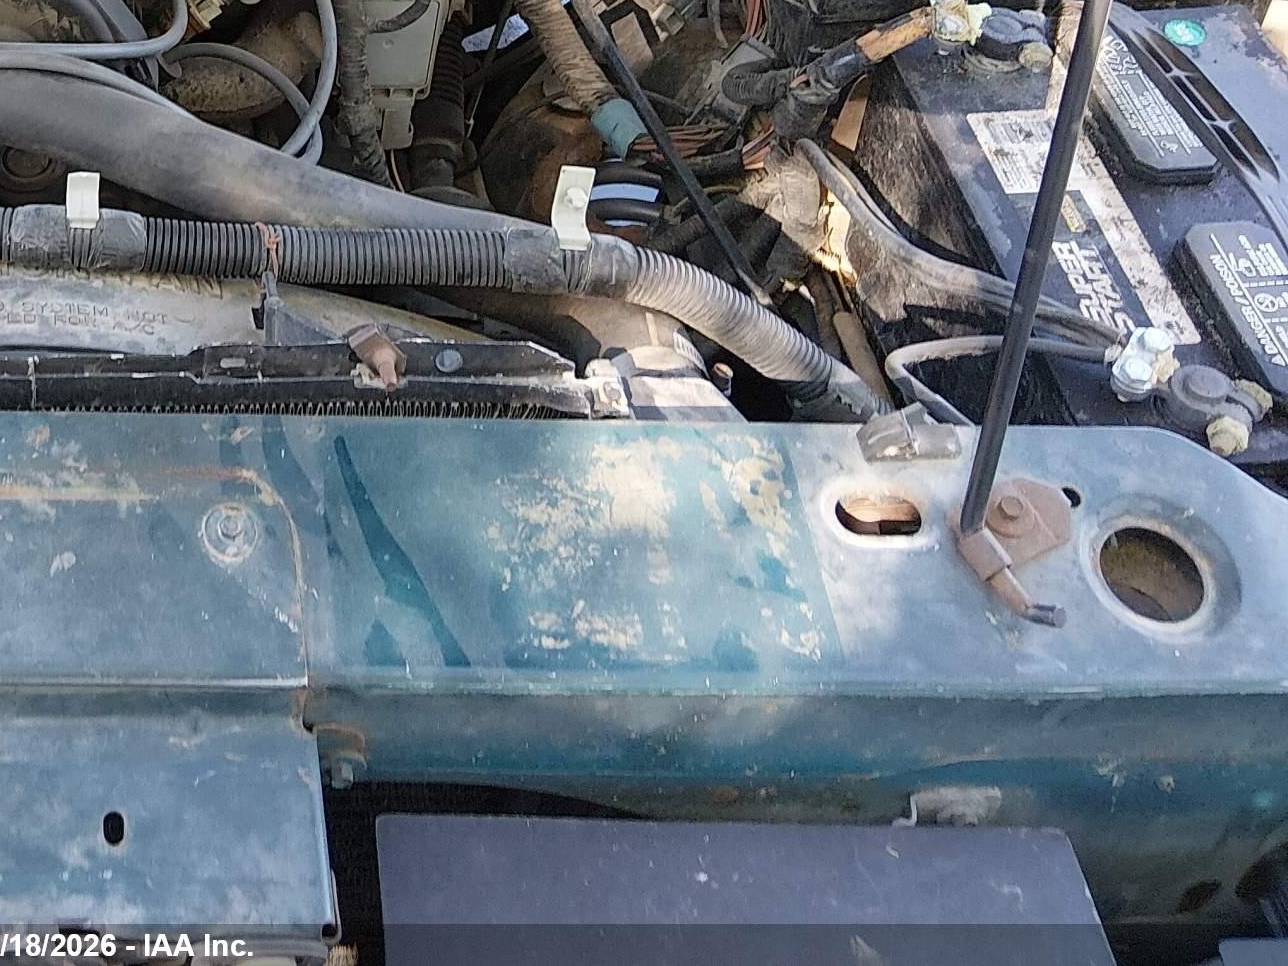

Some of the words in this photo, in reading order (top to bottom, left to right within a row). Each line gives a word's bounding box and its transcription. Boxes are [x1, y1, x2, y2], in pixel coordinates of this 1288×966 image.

[1051, 240, 1107, 323] SUPER
[1072, 240, 1137, 333] START
[1210, 254, 1243, 296] POISON
[21, 300, 110, 318] SYSTEM
[1241, 305, 1279, 356] DANGER
